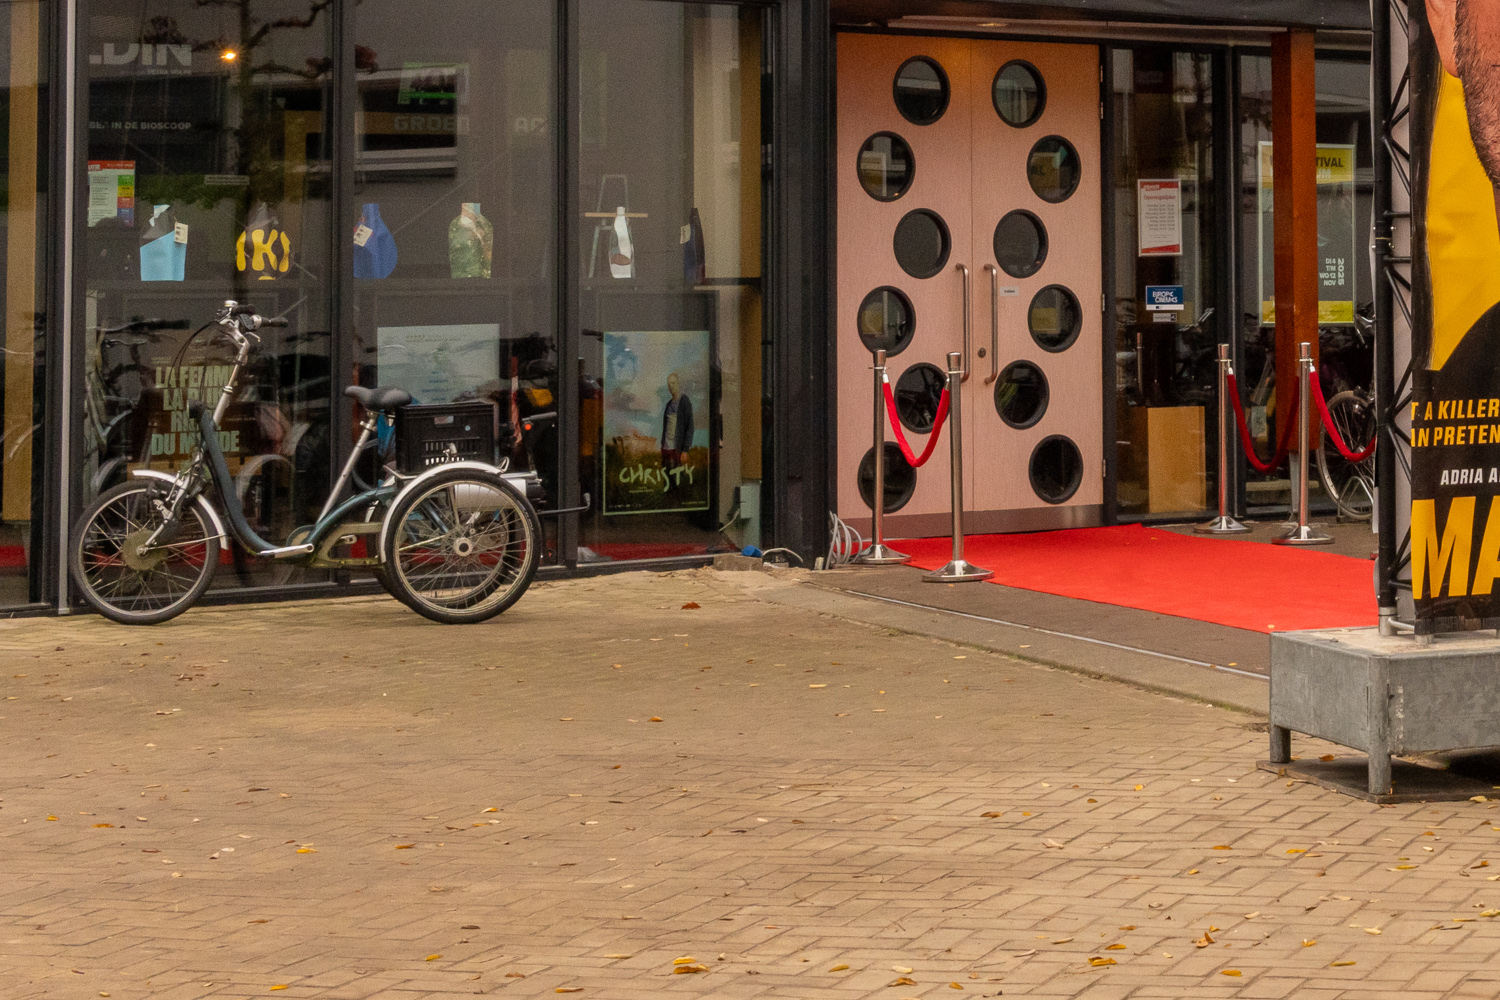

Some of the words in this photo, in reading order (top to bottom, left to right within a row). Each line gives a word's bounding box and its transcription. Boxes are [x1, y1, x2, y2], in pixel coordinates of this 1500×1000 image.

[140, 122, 192, 130] BIOSCOOP
[1424, 401, 1433, 420] A
[151, 433, 176, 455] DU
[1440, 468, 1483, 485] ADRIA
